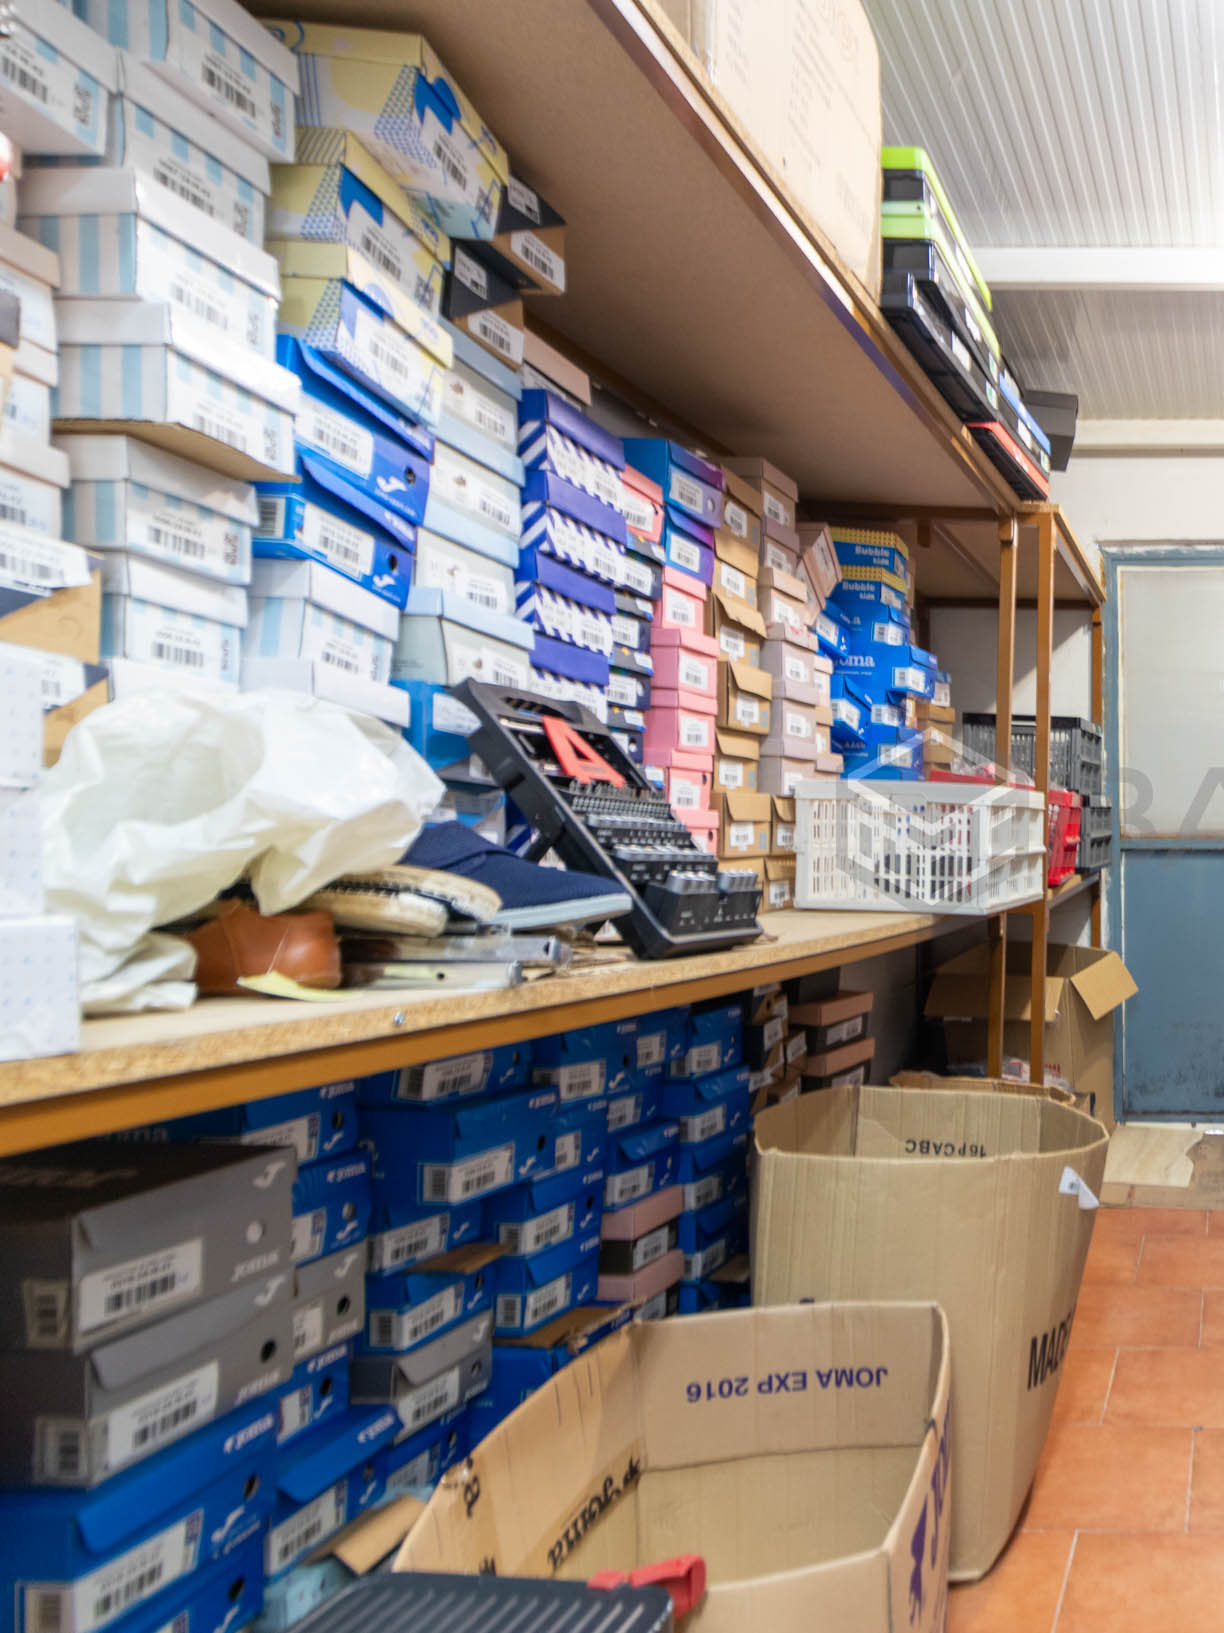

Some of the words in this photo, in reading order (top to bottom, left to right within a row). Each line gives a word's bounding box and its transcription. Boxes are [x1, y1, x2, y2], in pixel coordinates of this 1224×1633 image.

[855, 545, 890, 557] Bubble
[1027, 1311, 1072, 1391] MAD
[686, 1376, 749, 1403] 2016
[757, 1369, 808, 1395] EXP
[816, 1365, 888, 1389] JOMA
